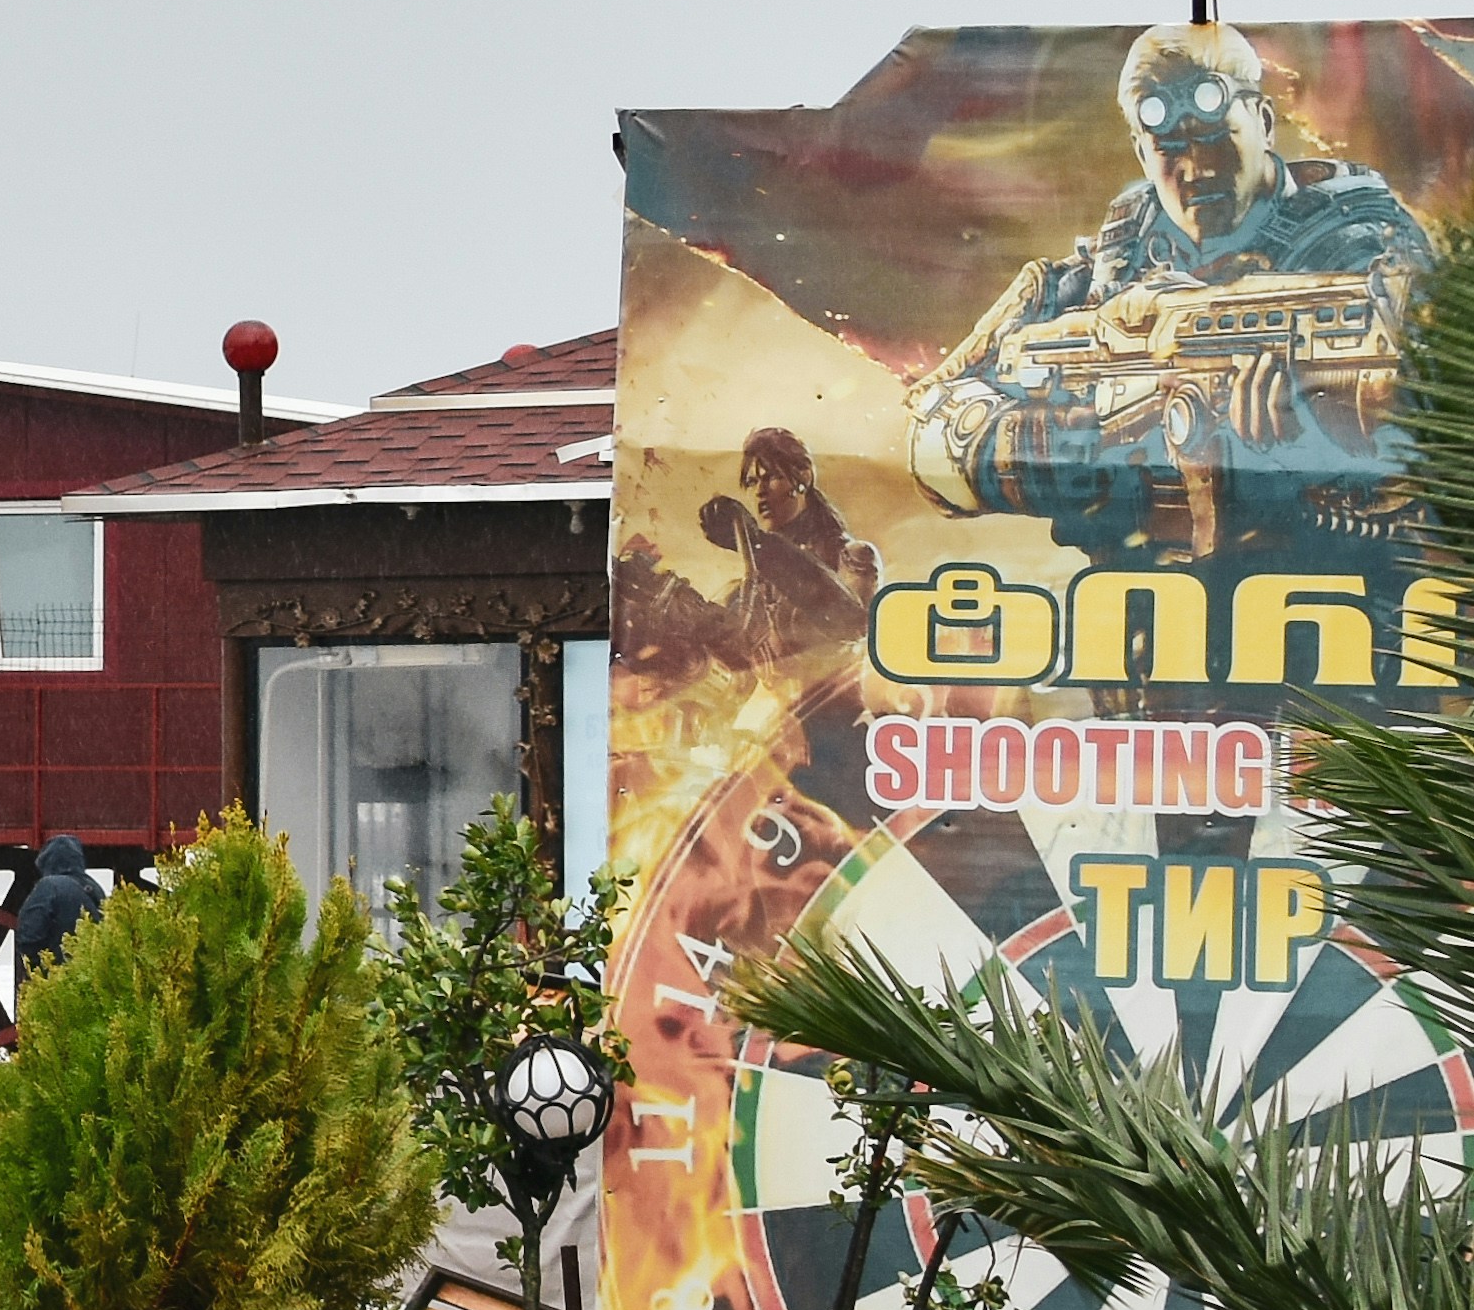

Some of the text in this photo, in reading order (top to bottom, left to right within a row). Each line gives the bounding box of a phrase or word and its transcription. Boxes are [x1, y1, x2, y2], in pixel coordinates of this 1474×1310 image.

[870, 721, 1270, 812] SHOOTING
[745, 808, 803, 868] 9
[1076, 859, 1329, 985] ТИР
[653, 932, 737, 1025] 14
[628, 1094, 696, 1173] 11
